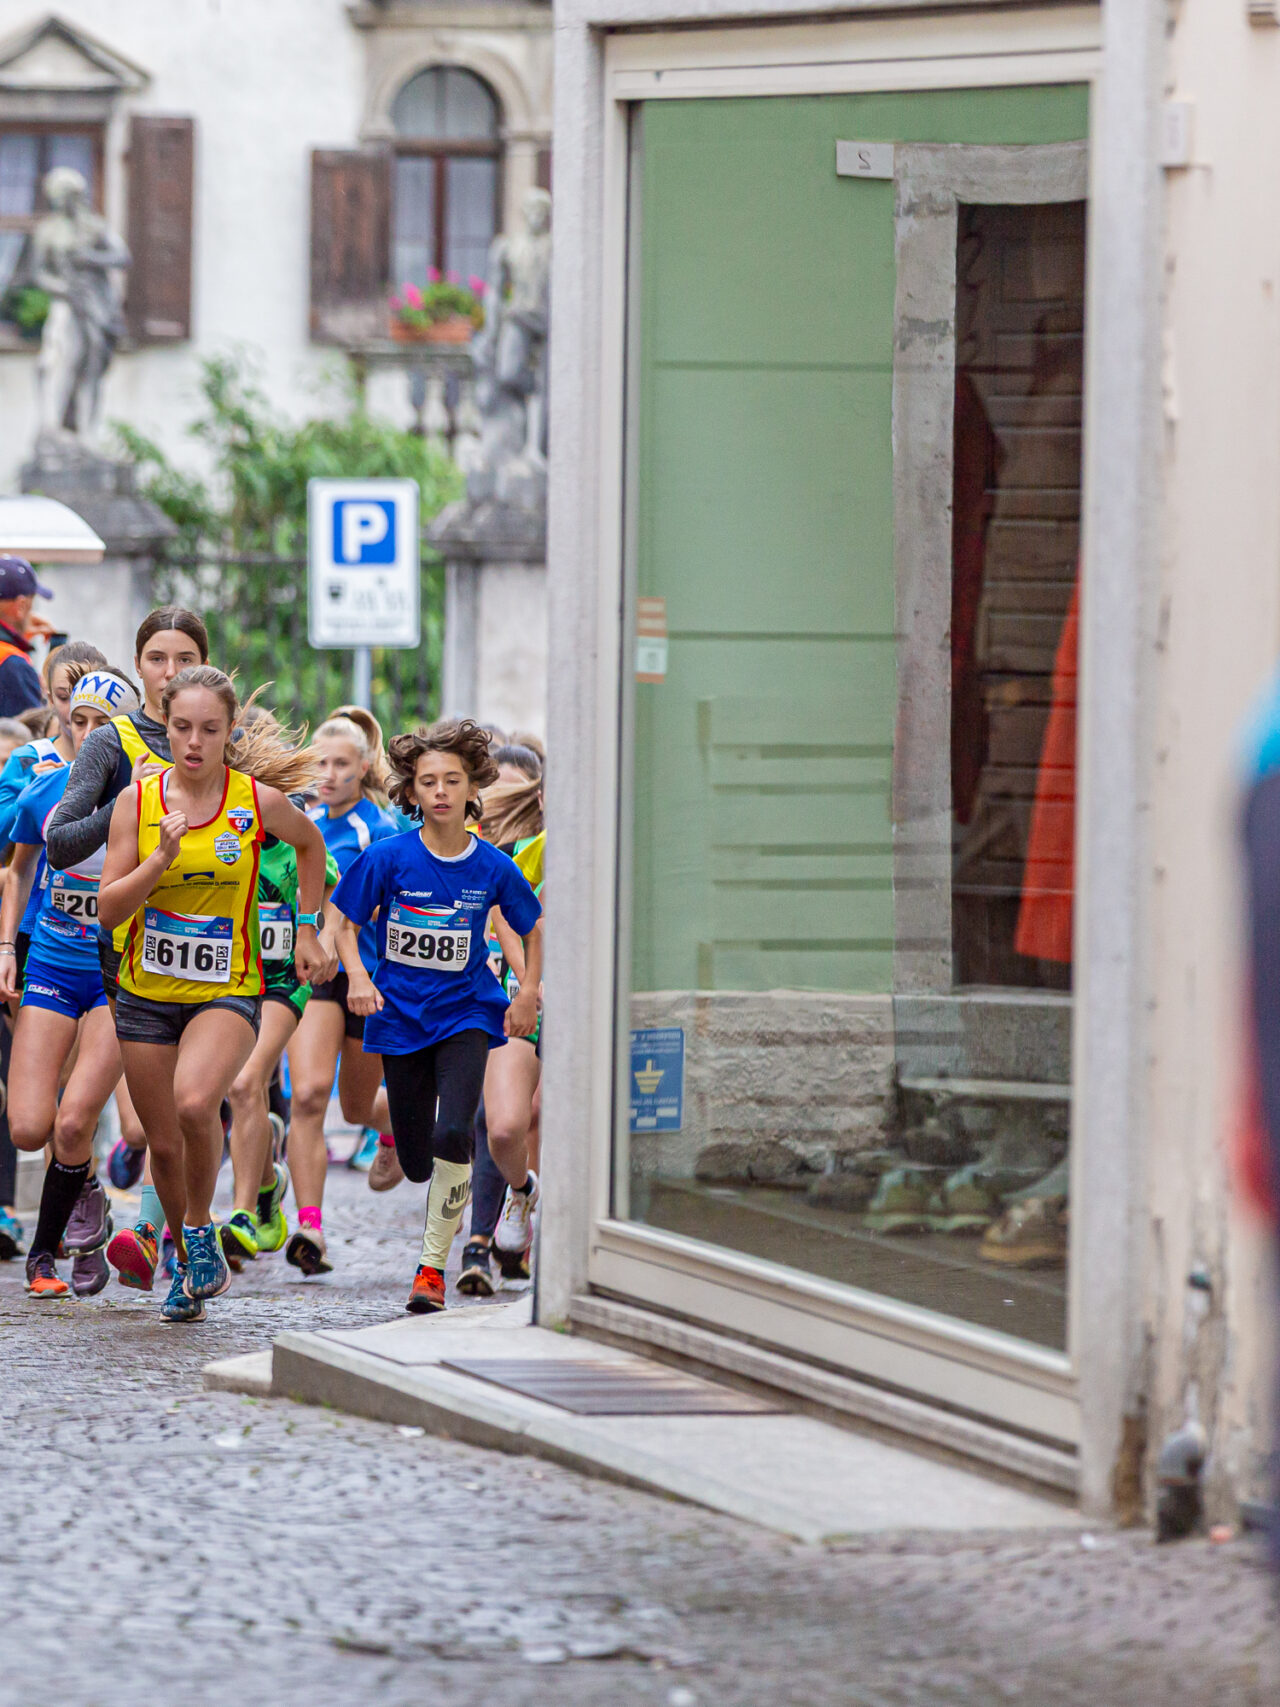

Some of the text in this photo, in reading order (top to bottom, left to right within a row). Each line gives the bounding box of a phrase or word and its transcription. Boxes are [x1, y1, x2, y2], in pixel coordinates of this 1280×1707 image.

[341, 501, 389, 564] P
[70, 675, 126, 709] WE
[157, 938, 214, 971] 616
[400, 931, 455, 962] 298
